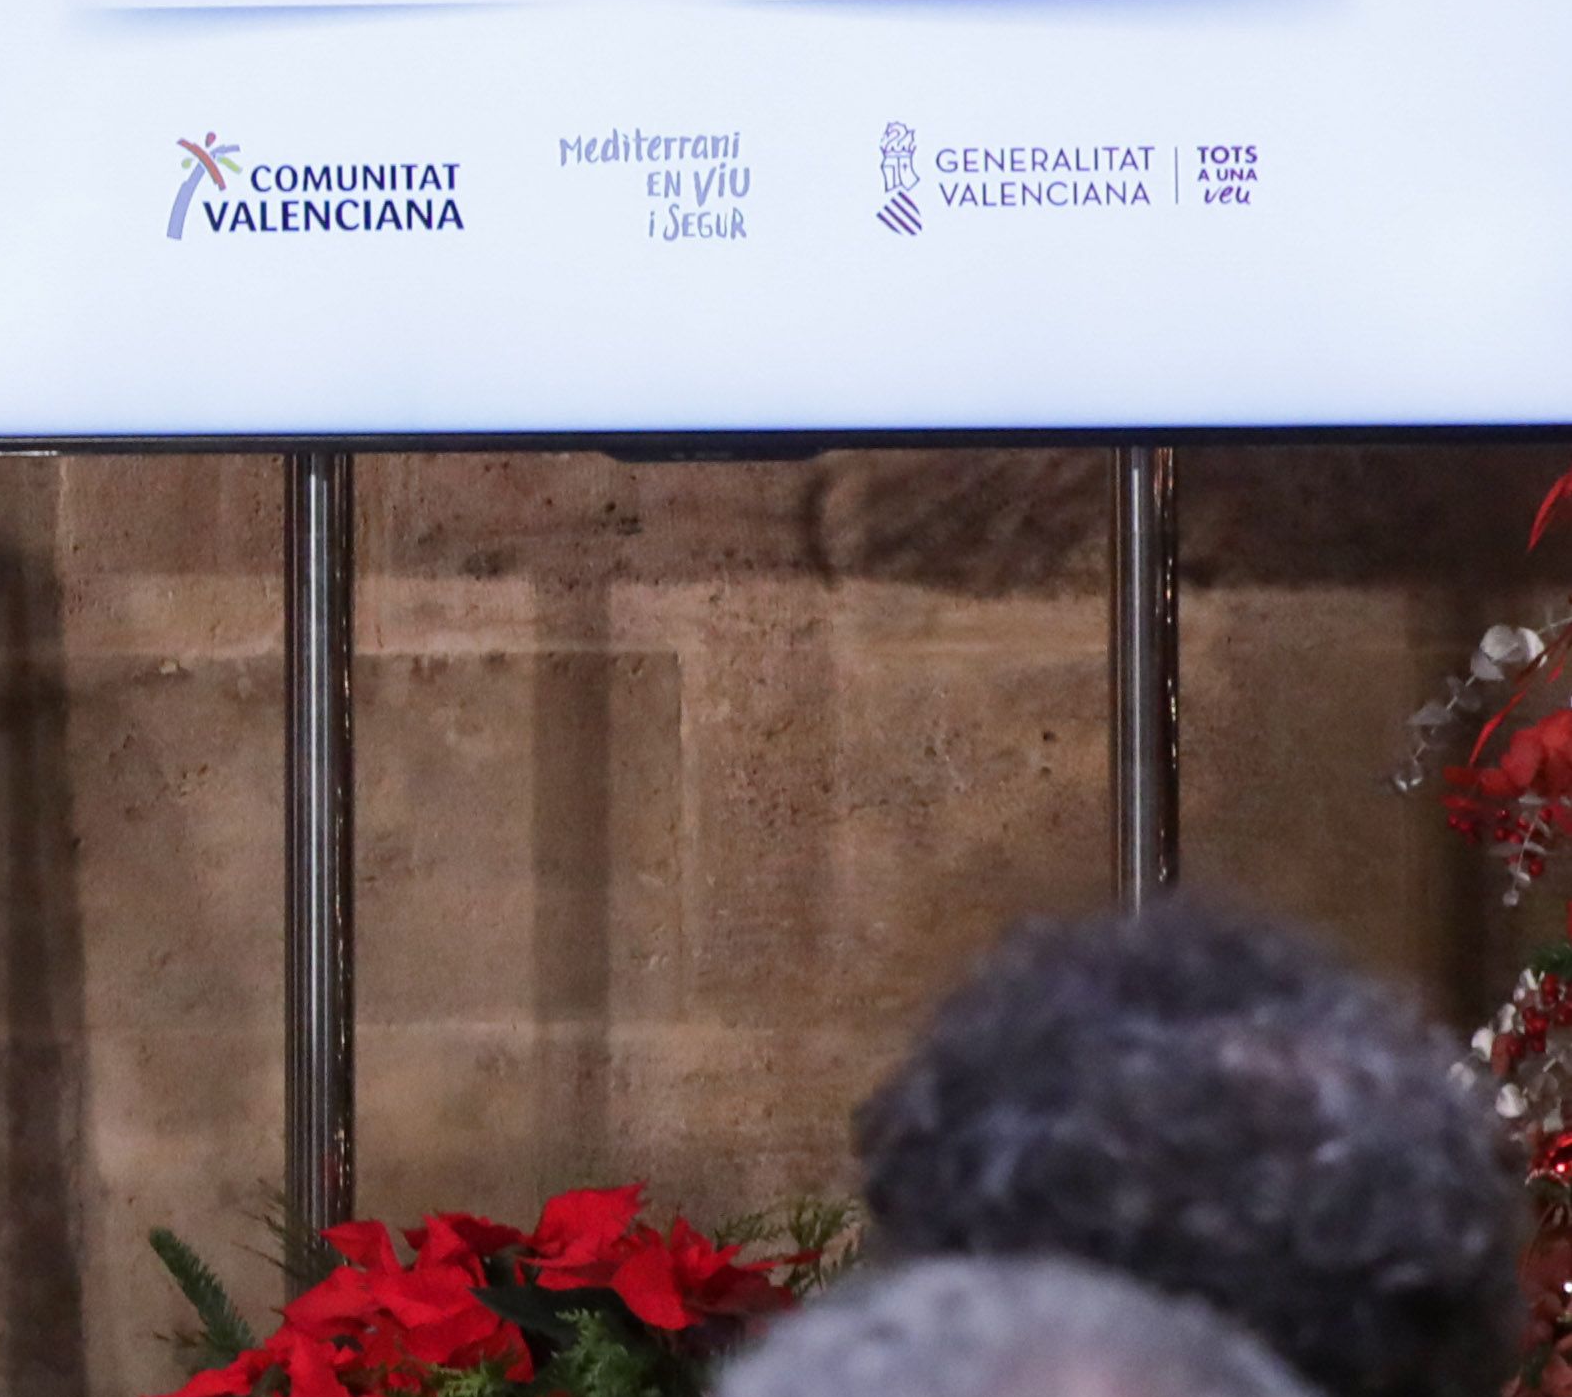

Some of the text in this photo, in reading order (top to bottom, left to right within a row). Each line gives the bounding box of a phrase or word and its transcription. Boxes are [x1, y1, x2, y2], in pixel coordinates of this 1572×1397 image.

[936, 147, 1154, 173] GENERALITAT
[1198, 146, 1257, 164] TOTS
[251, 164, 458, 192] COMUNITAT
[647, 170, 681, 198] EN
[1198, 168, 1257, 181] A UNA
[940, 181, 1150, 206] VALENCIANA
[1204, 186, 1249, 204] veu
[204, 199, 463, 231] VALENCIANA
